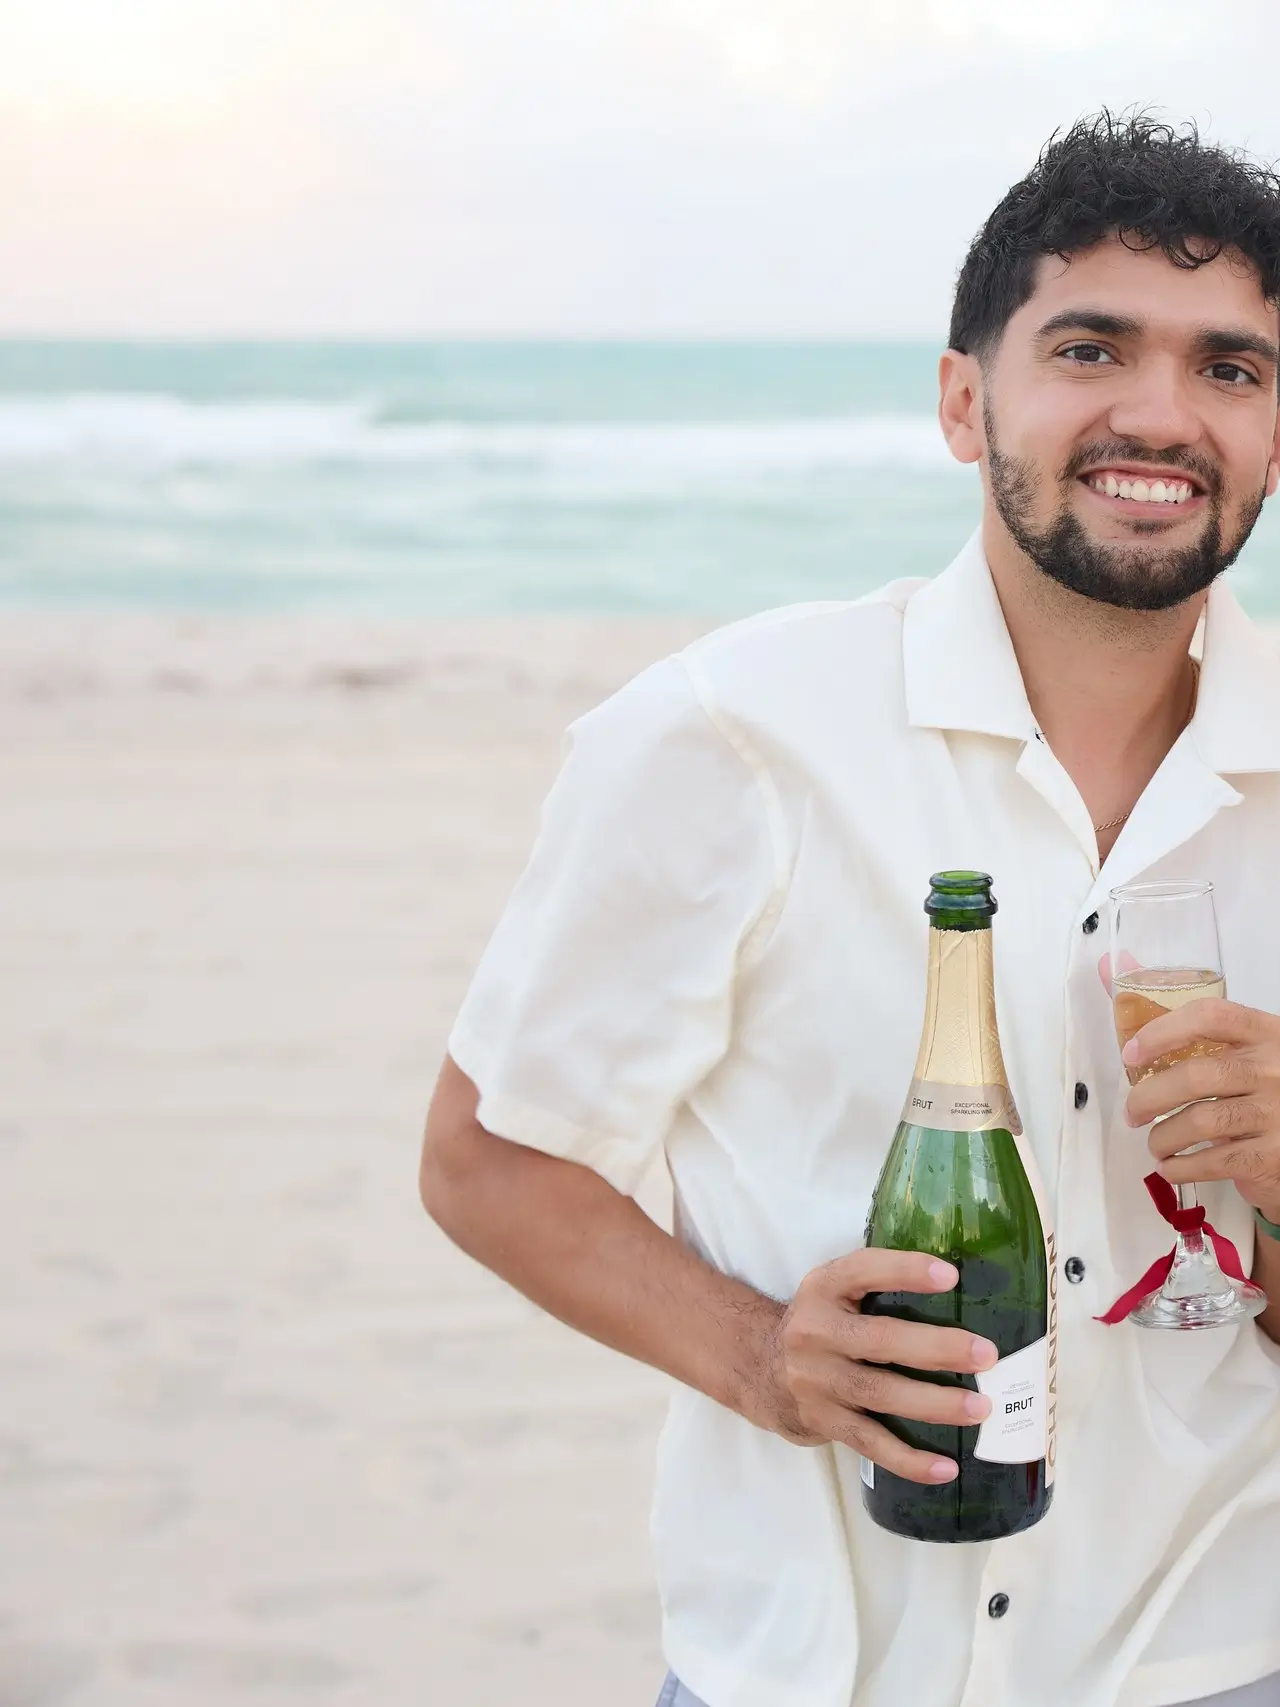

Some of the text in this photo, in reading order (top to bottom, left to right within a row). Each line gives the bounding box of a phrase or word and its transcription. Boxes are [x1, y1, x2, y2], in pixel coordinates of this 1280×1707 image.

[912, 1097, 933, 1110] BRUT
[1047, 1231, 1057, 1468] CHANDON
[1005, 1396, 1034, 1414] BRUT
